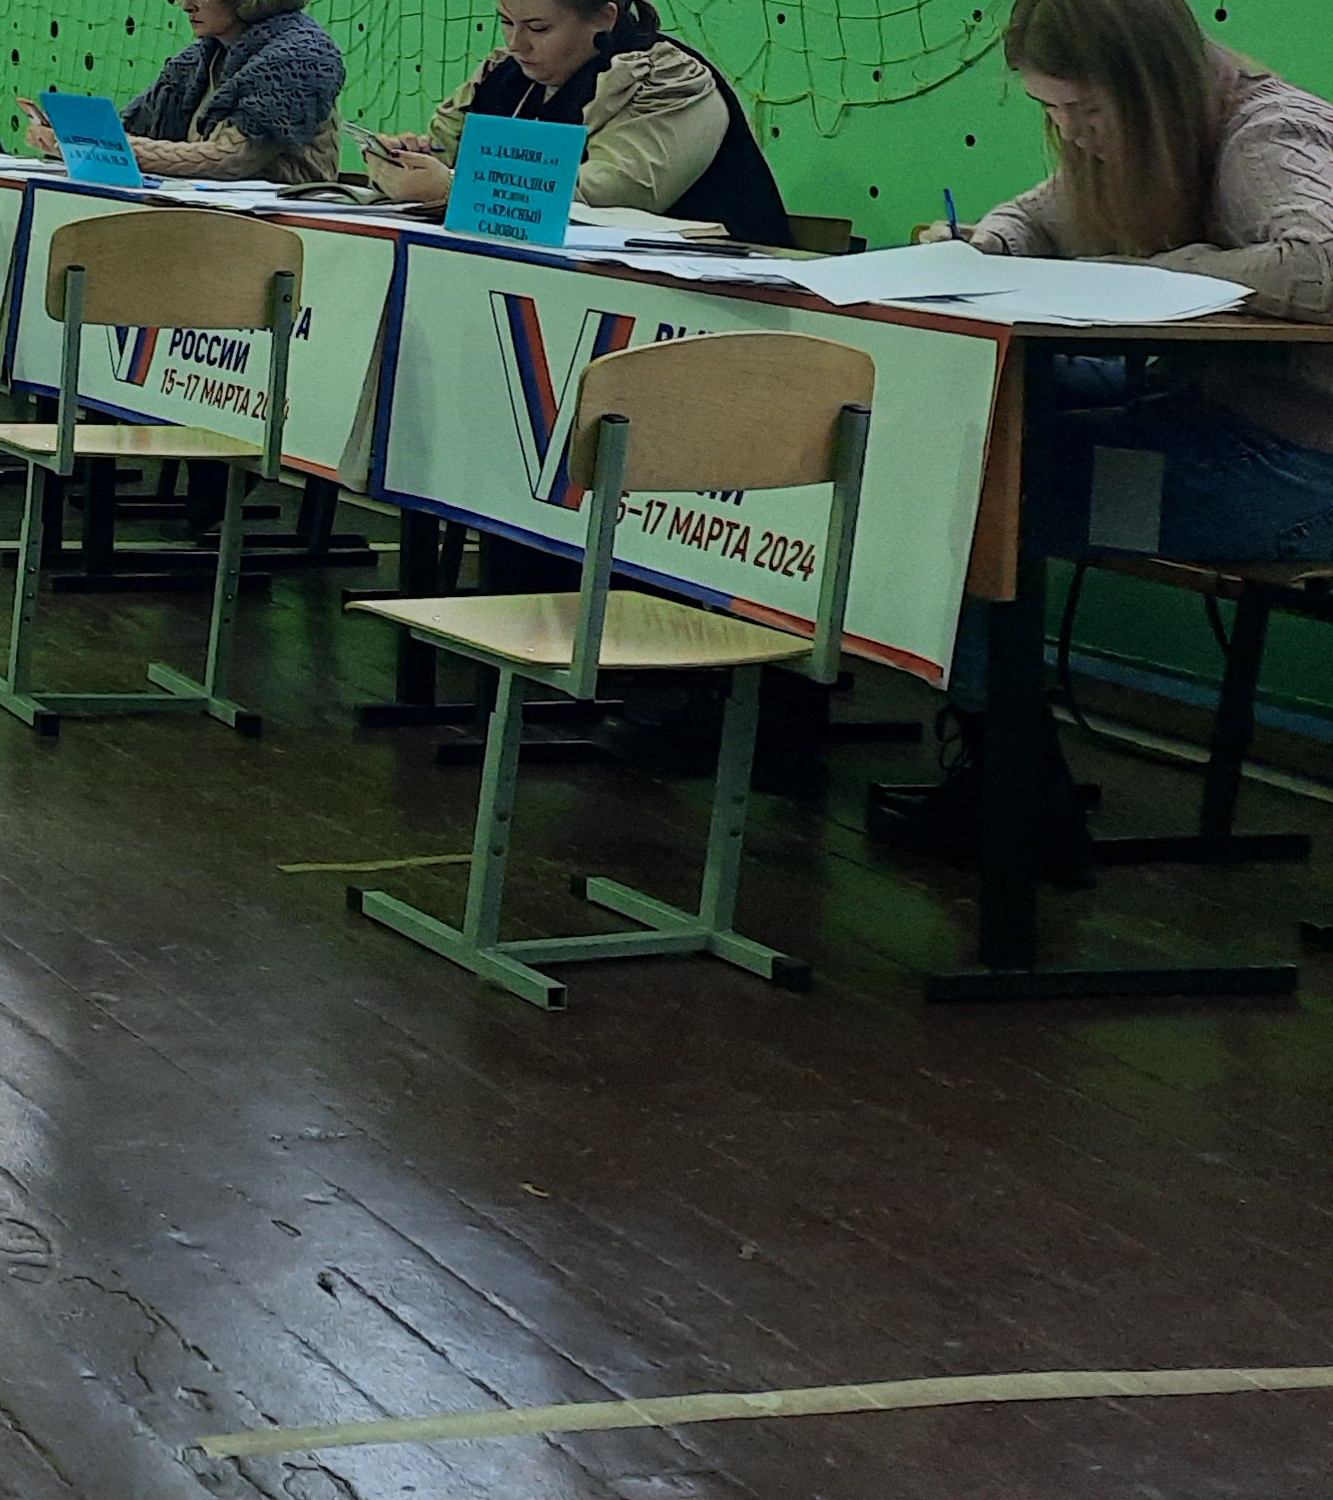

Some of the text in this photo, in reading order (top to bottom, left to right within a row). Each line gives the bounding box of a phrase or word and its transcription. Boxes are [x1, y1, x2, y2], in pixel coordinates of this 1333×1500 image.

[488, 170, 556, 194] ПРОХЛАДНАЯ
[168, 328, 251, 374] РОССИИ
[160, 368, 200, 401] 15-17
[199, 378, 251, 417] МАРТА
[616, 490, 816, 582] 5-17 МАРТА 2024
